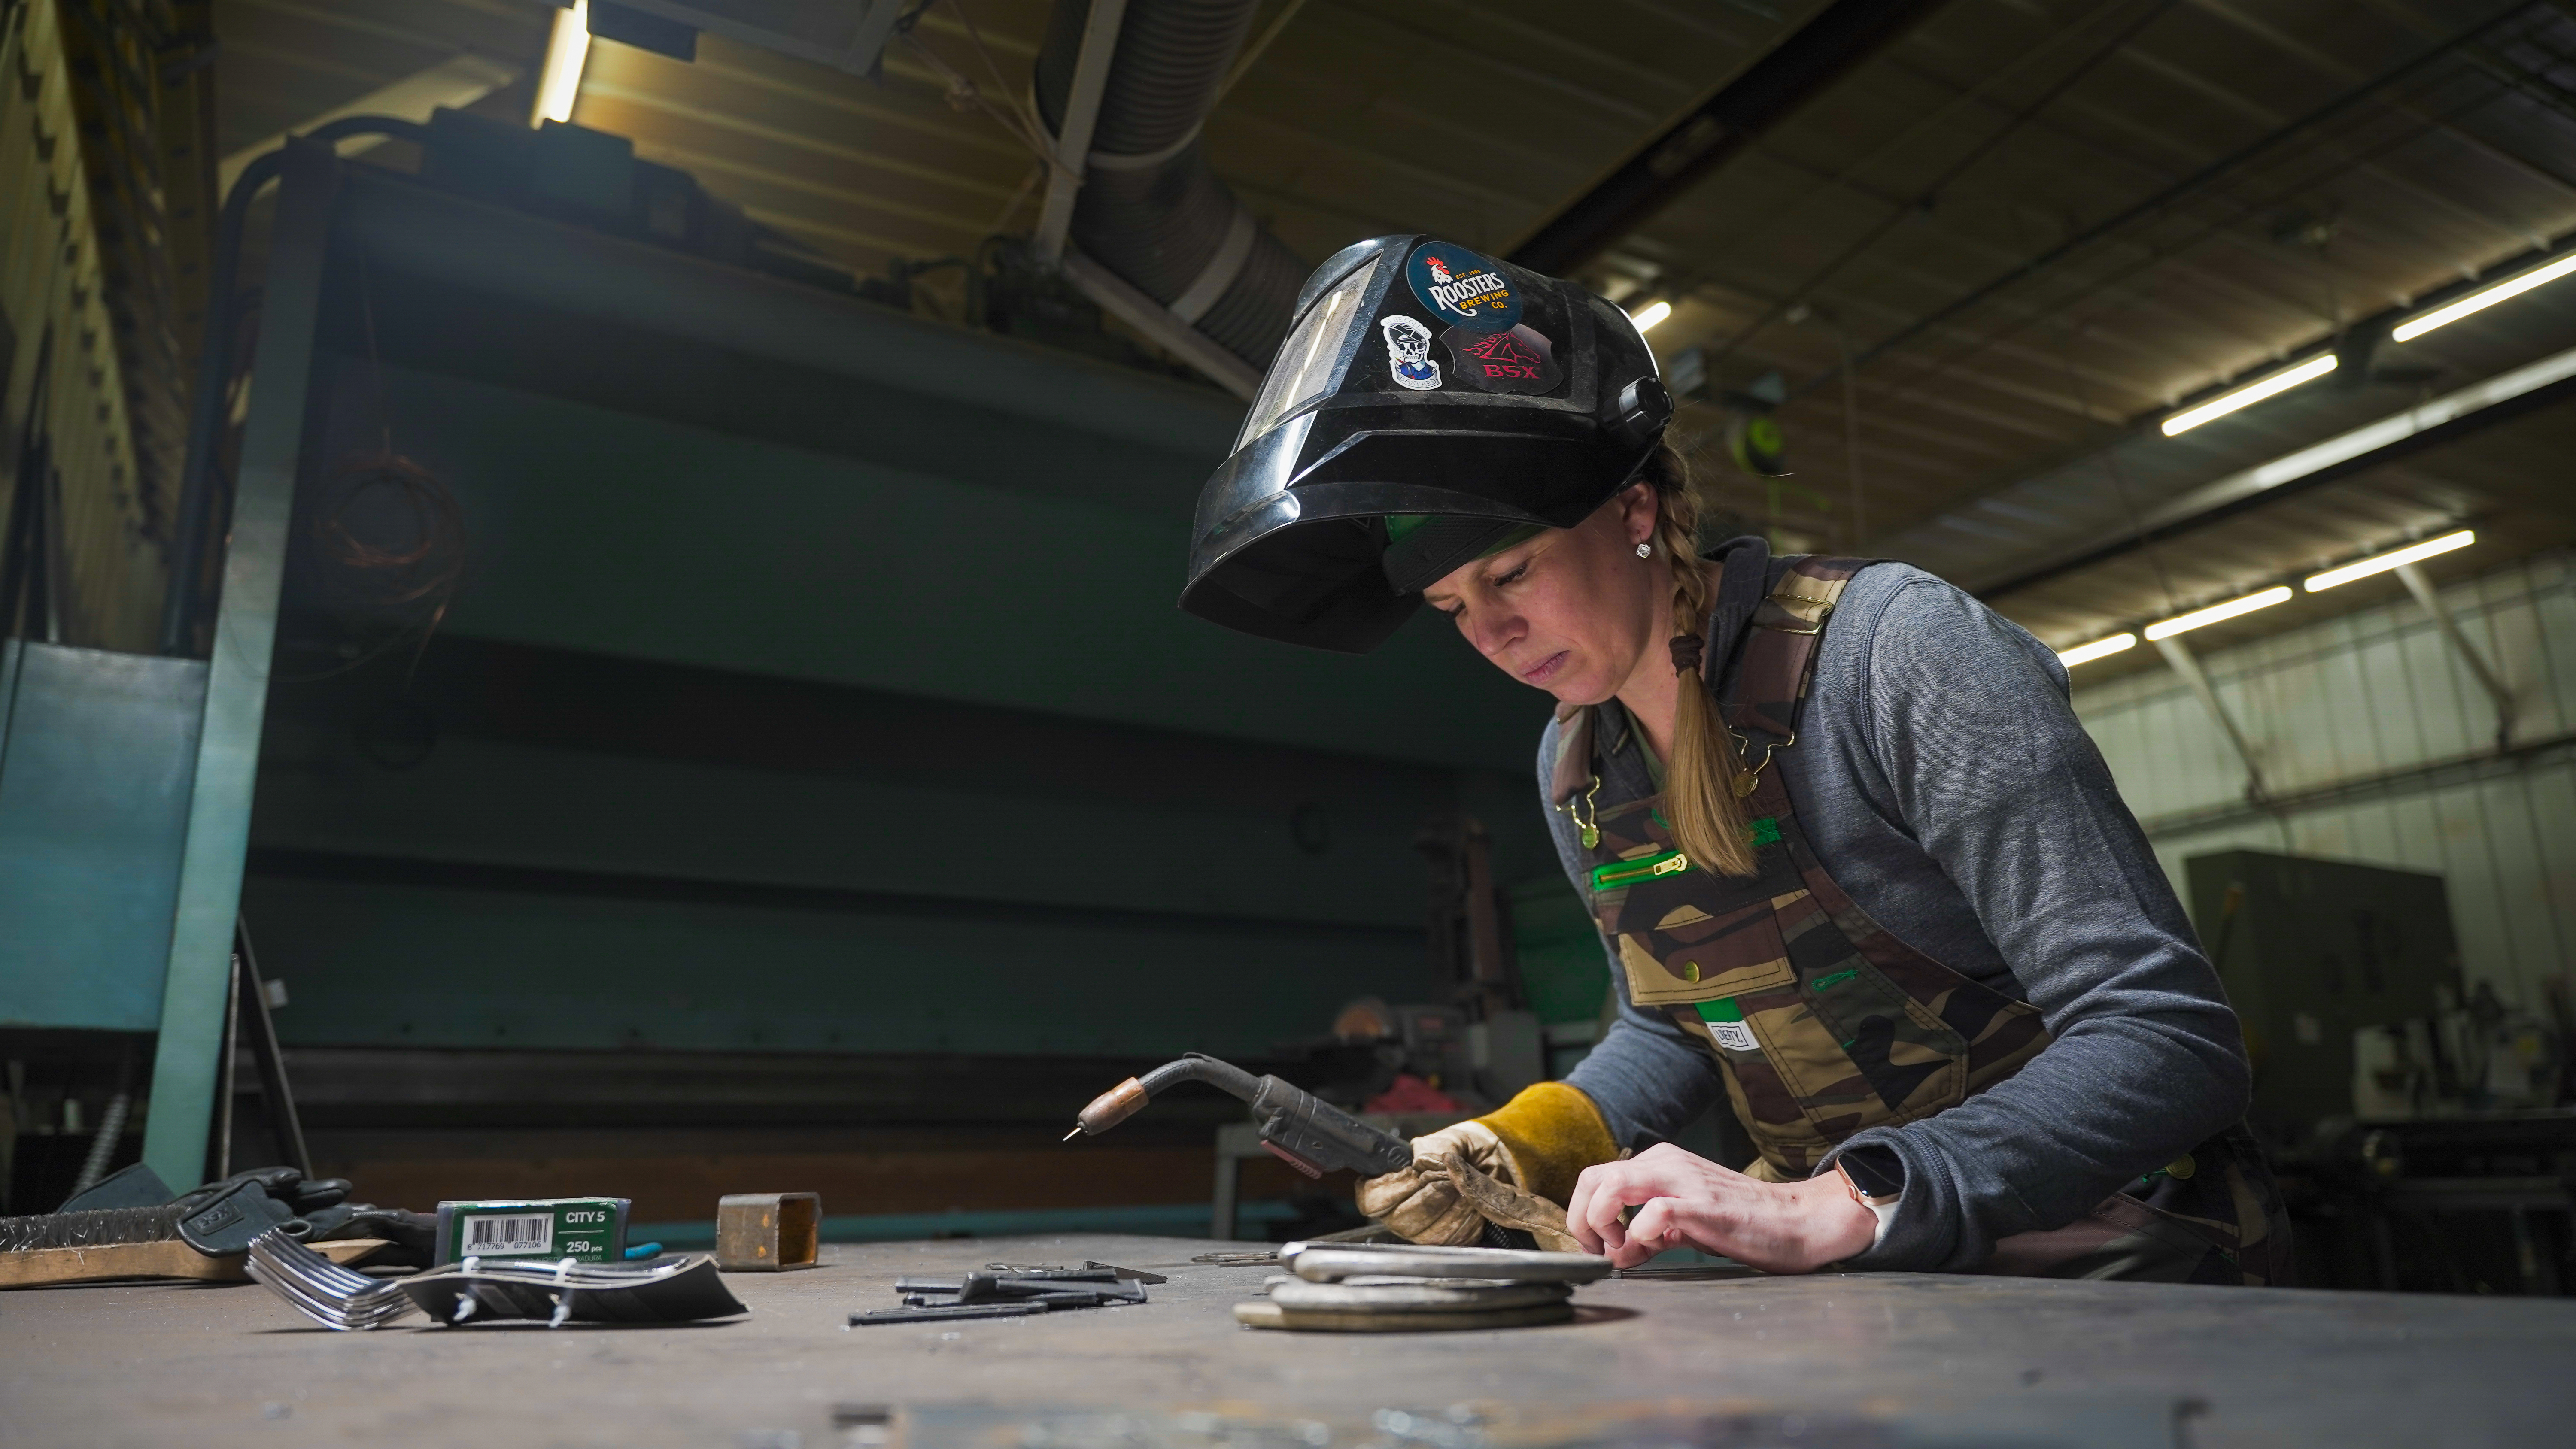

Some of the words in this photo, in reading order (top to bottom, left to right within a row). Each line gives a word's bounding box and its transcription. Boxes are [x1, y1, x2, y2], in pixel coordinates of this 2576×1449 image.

[1428, 272, 1505, 317] ROOSTERS
[1459, 290, 1509, 309] BREWING
[1384, 316, 1403, 326] BLUE
[1404, 318, 1430, 338] COLLAR
[1482, 365, 1540, 379] BSX
[1399, 375, 1437, 387] BASTARD
[566, 1211, 596, 1223] CITY
[596, 1211, 605, 1222] 5
[566, 1241, 590, 1252] 250
